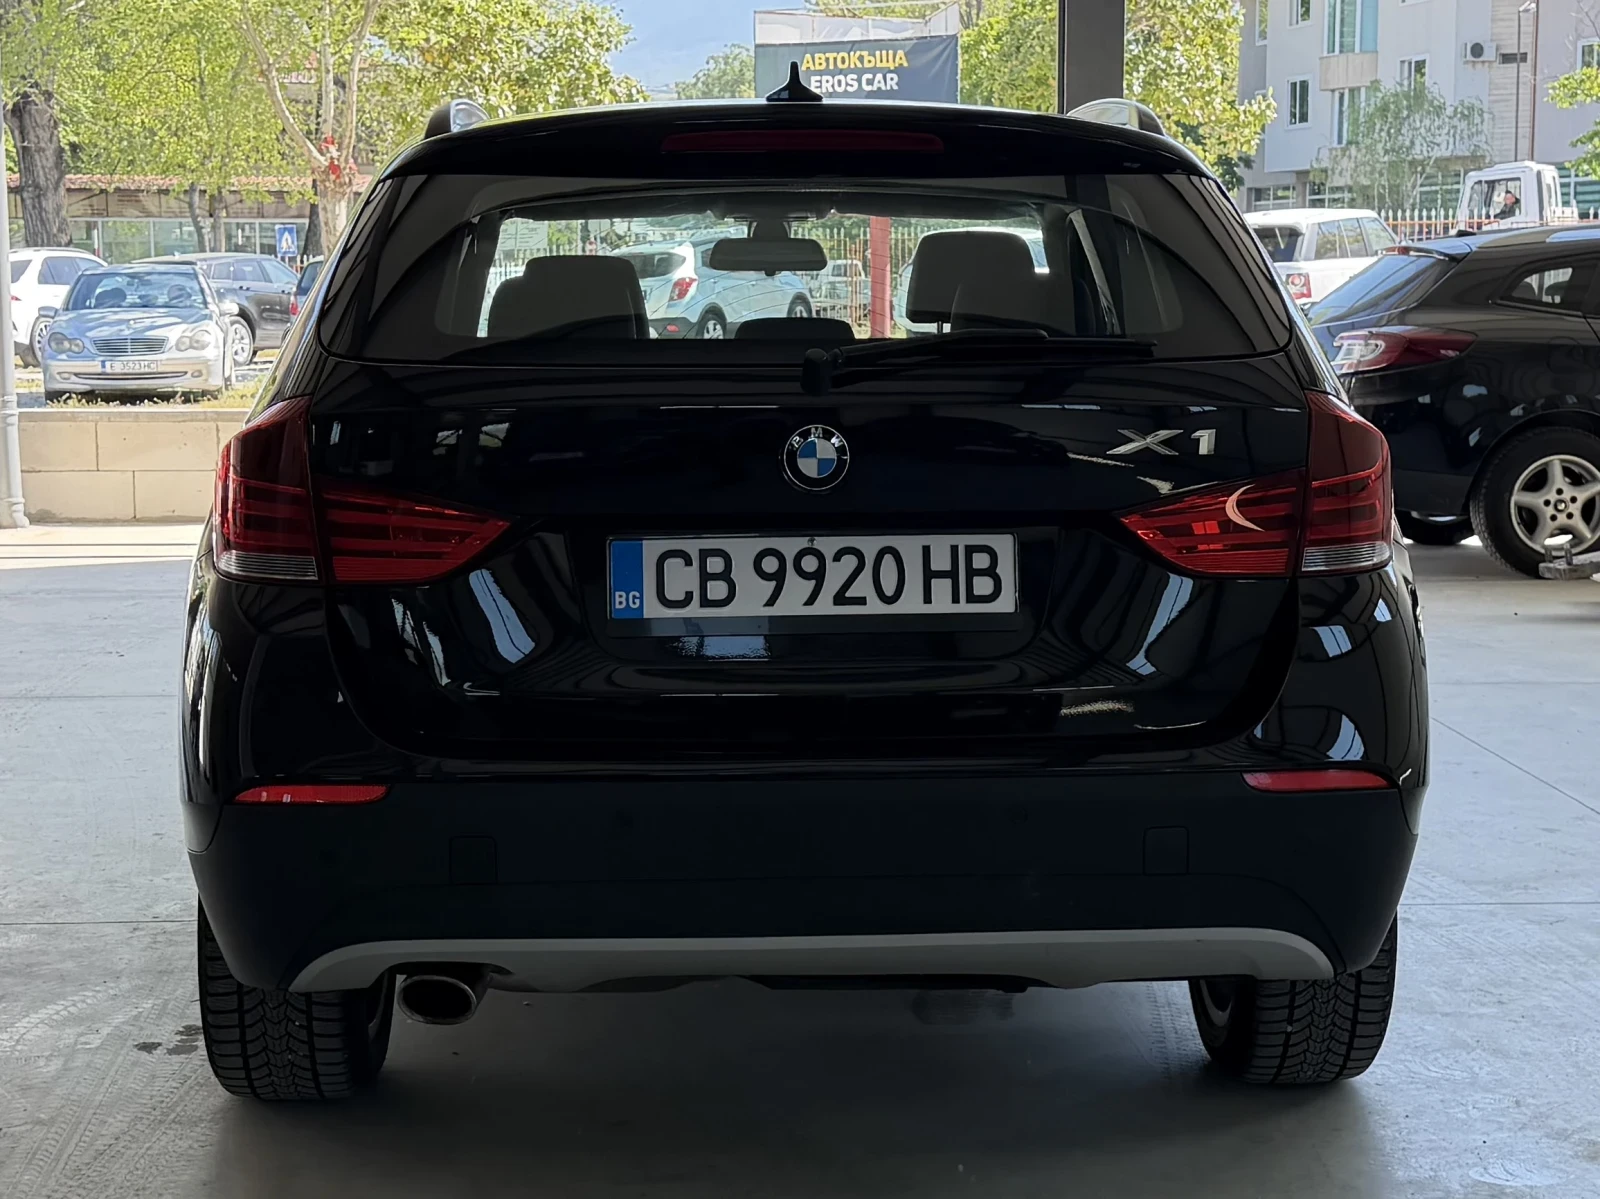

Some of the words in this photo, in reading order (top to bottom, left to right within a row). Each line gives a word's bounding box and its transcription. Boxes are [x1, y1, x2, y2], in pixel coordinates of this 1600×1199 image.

[801, 50, 908, 71] АВТОКЪЩА
[810, 74, 859, 93] EROS
[861, 73, 899, 91] CAR
[656, 548, 737, 609] CB
[753, 545, 906, 607] 9920
[922, 544, 1003, 605] HB
[614, 591, 641, 609] BG
